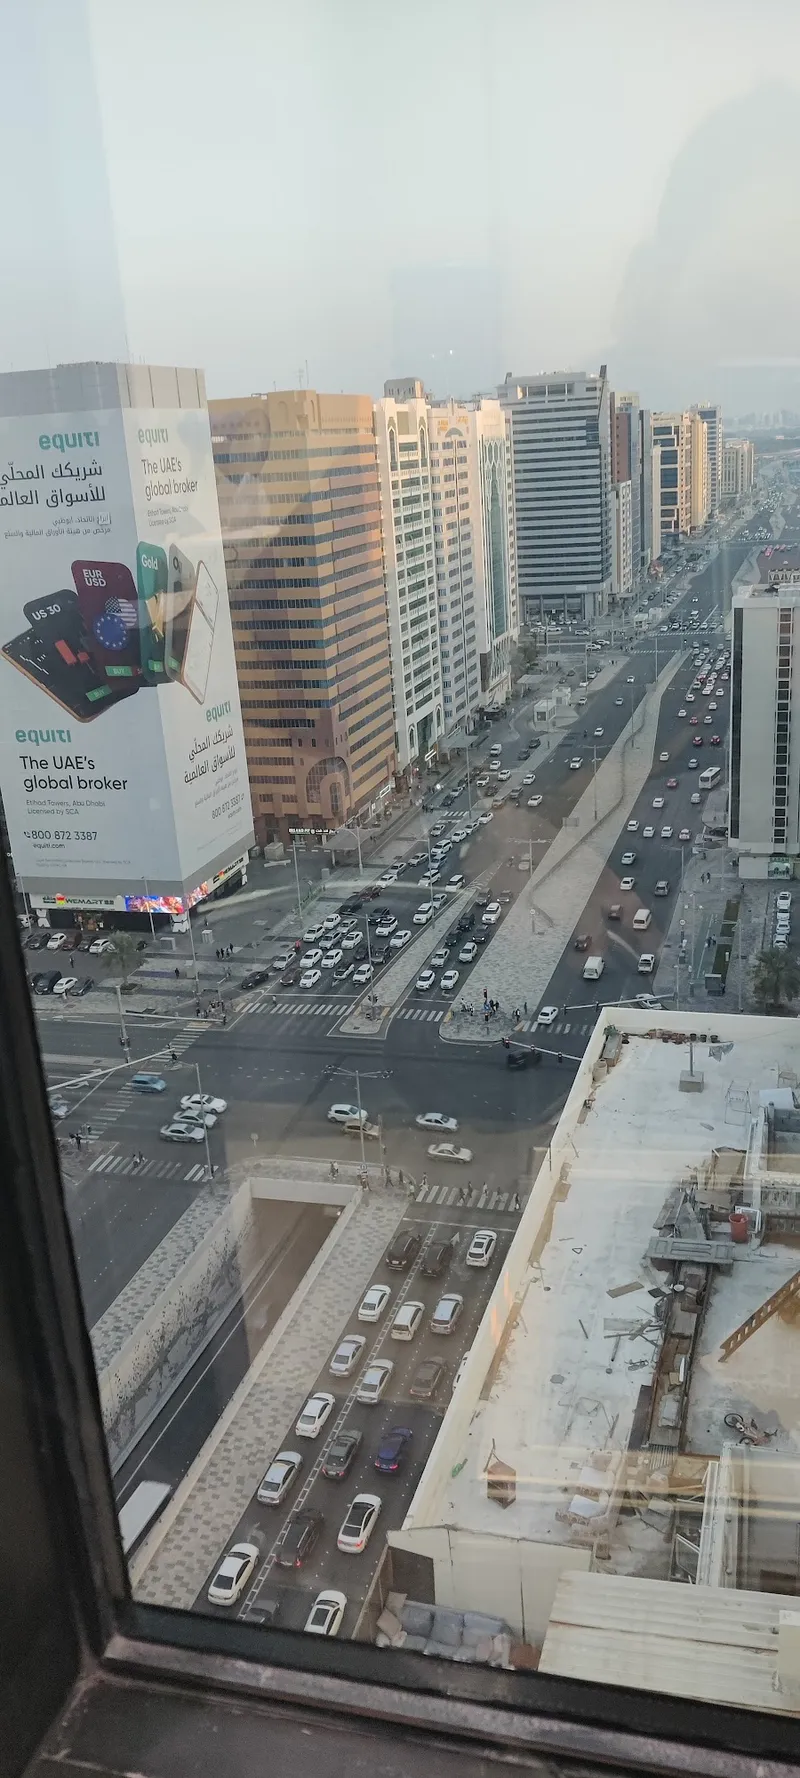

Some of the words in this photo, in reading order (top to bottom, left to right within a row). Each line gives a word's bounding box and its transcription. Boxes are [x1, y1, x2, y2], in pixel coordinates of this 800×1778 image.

[39, 431, 100, 453] equiti
[138, 428, 169, 447] equiti
[51, 459, 103, 481] شريكك
[141, 459, 158, 475] The
[160, 456, 182, 473] UAE's
[46, 483, 106, 508] للأسواق
[145, 478, 172, 501] global
[172, 477, 198, 494] broker
[141, 554, 159, 570] Gold
[82, 569, 103, 578] EUR
[84, 578, 107, 587] USD
[31, 609, 48, 621] US
[46, 604, 61, 615] 30
[206, 700, 231, 722] equiti
[15, 729, 72, 746] equiti
[212, 724, 234, 745] شريكك
[19, 755, 49, 770] The
[52, 755, 95, 770] UAE's
[23, 775, 73, 792] global
[76, 775, 128, 790] broker
[56, 808, 64, 816] by
[31, 830, 51, 840] 800
[54, 830, 72, 840] 872
[74, 831, 98, 841] 3387
